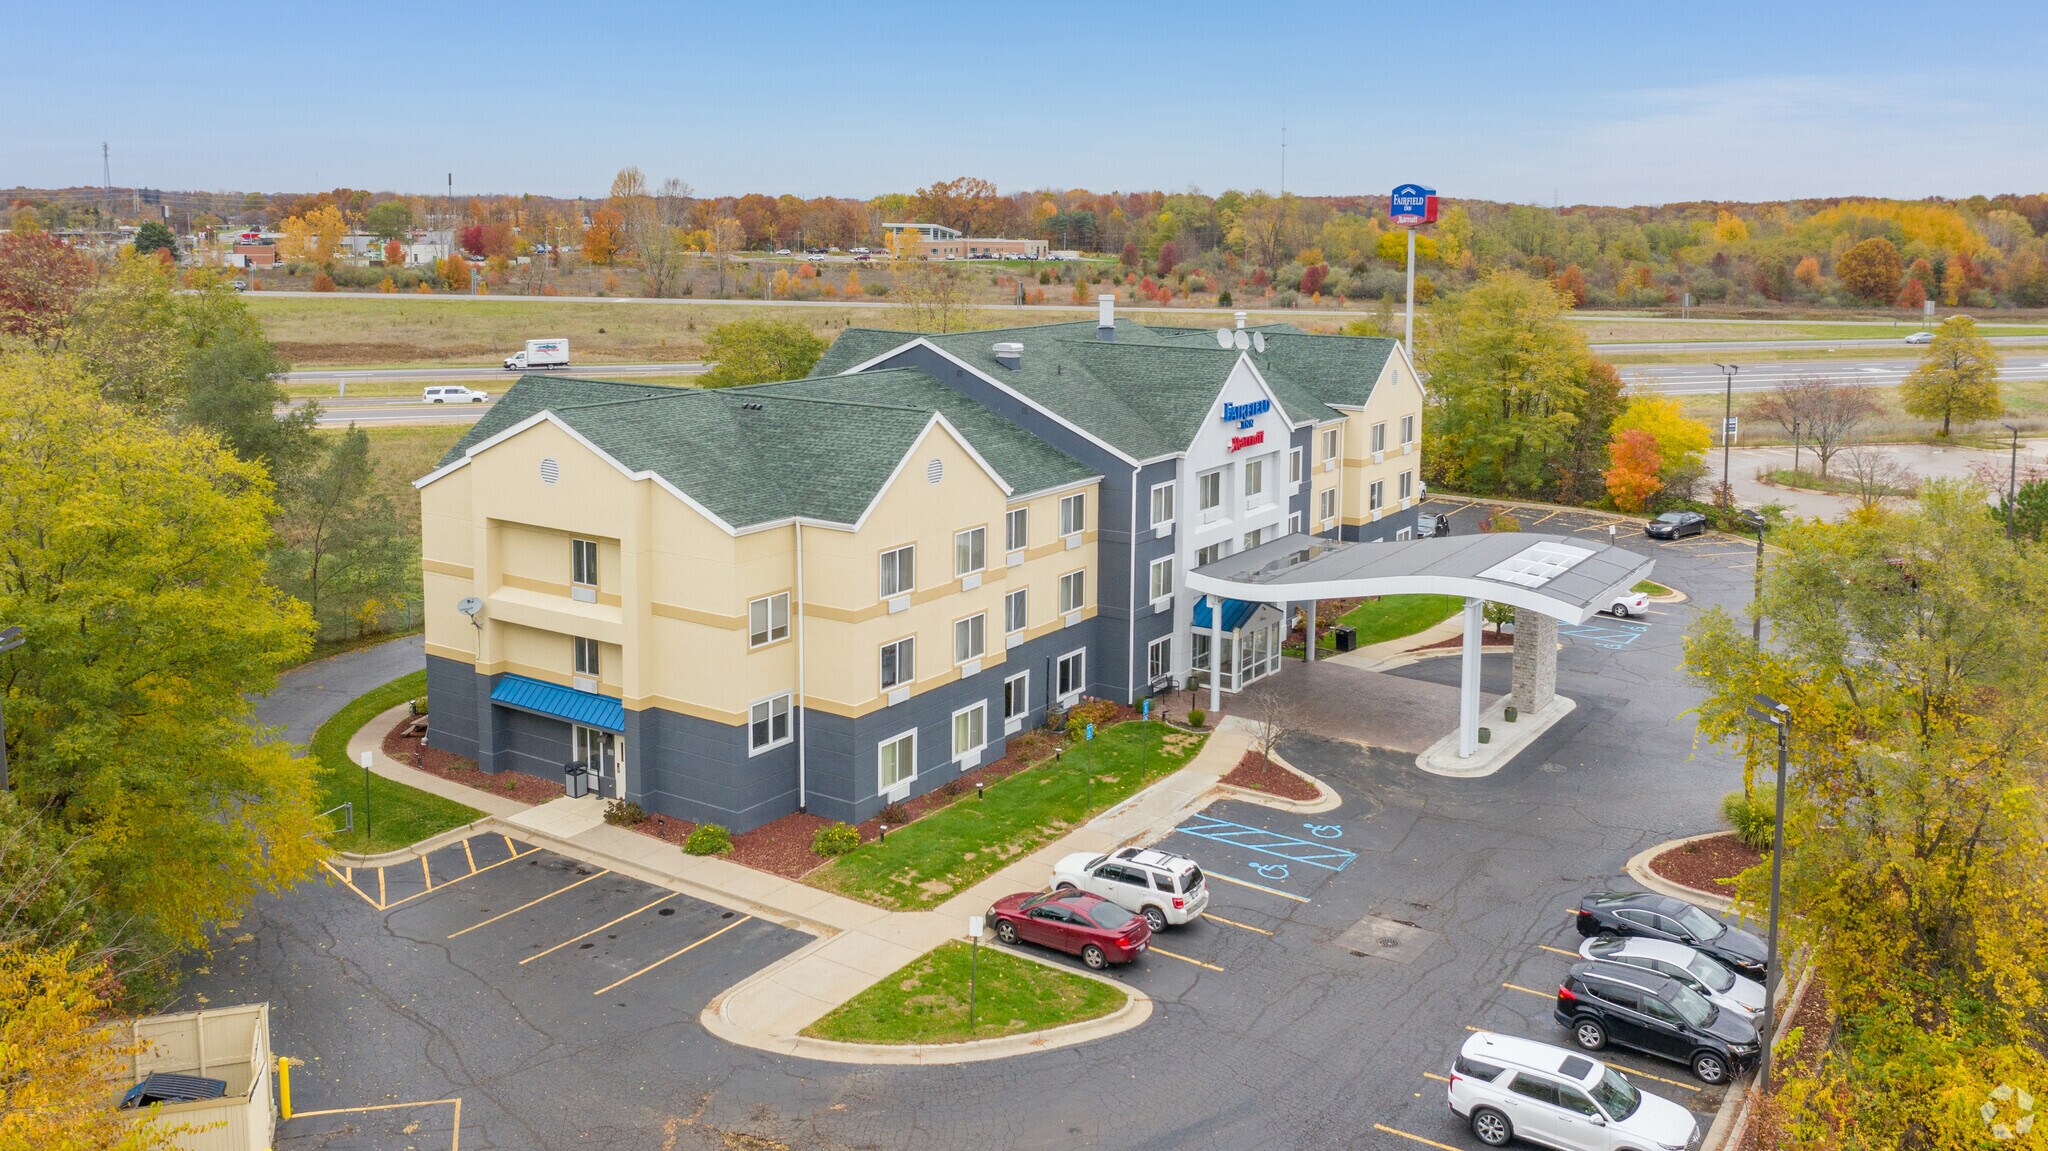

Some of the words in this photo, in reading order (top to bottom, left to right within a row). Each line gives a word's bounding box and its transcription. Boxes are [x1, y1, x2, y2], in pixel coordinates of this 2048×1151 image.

[1393, 194, 1424, 206] FAIRFIELD
[1223, 399, 1271, 422] FAIRFIELD
[1240, 419, 1254, 430] INN
[1229, 430, 1264, 453] Marriott
